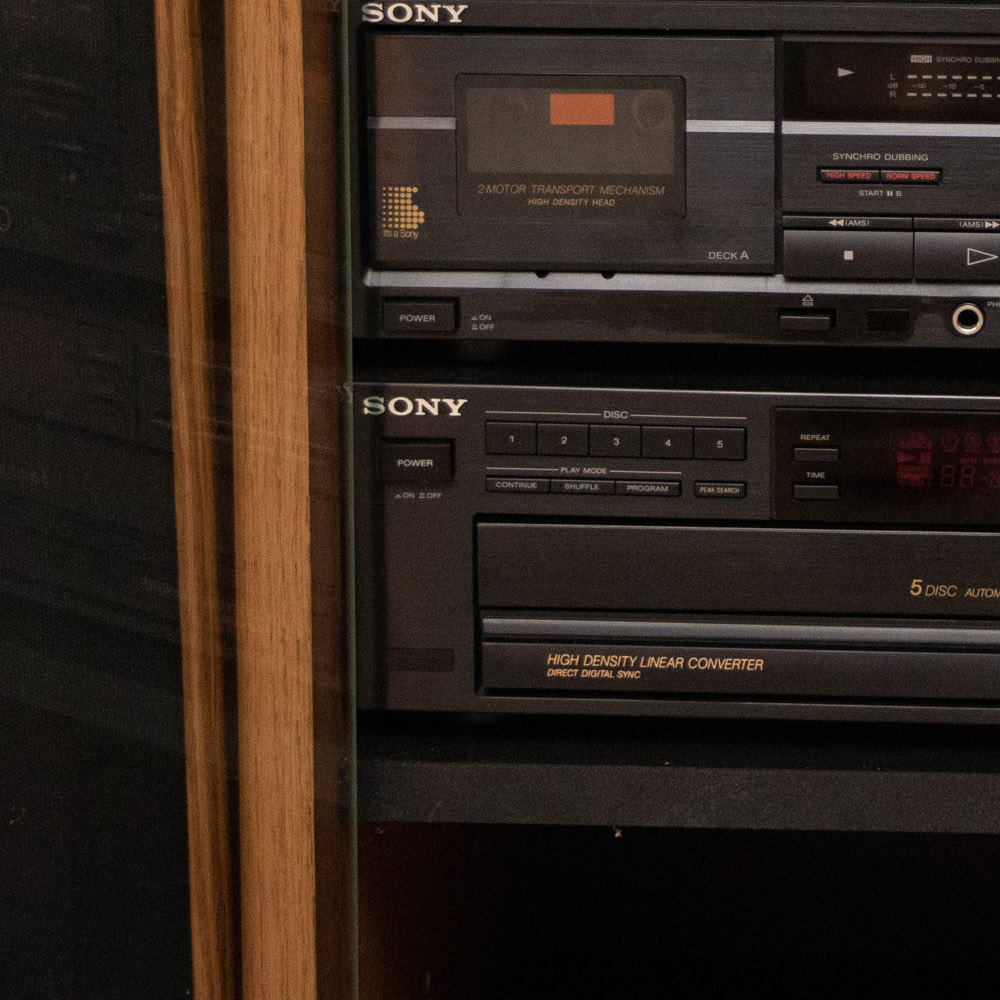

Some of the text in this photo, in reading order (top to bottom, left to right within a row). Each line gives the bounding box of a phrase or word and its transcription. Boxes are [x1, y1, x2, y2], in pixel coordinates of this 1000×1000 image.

[363, 3, 467, 22] SONY
[833, 153, 929, 161] SYNCHRO DUBBING
[487, 185, 526, 194] MOTOR
[532, 185, 595, 194] TRANSPORT
[600, 186, 665, 195] MECHANISM
[592, 199, 615, 207] HEAD
[709, 249, 749, 259] DECK A
[363, 397, 467, 416] SONY
[397, 459, 433, 467] POWER
[910, 580, 922, 595] 5
[925, 585, 957, 597] DISC
[547, 654, 763, 671] HIGH DENSITY LINEAR CONVERTER
[547, 669, 578, 677] DIRECT
[581, 669, 614, 678] DIGITAL
